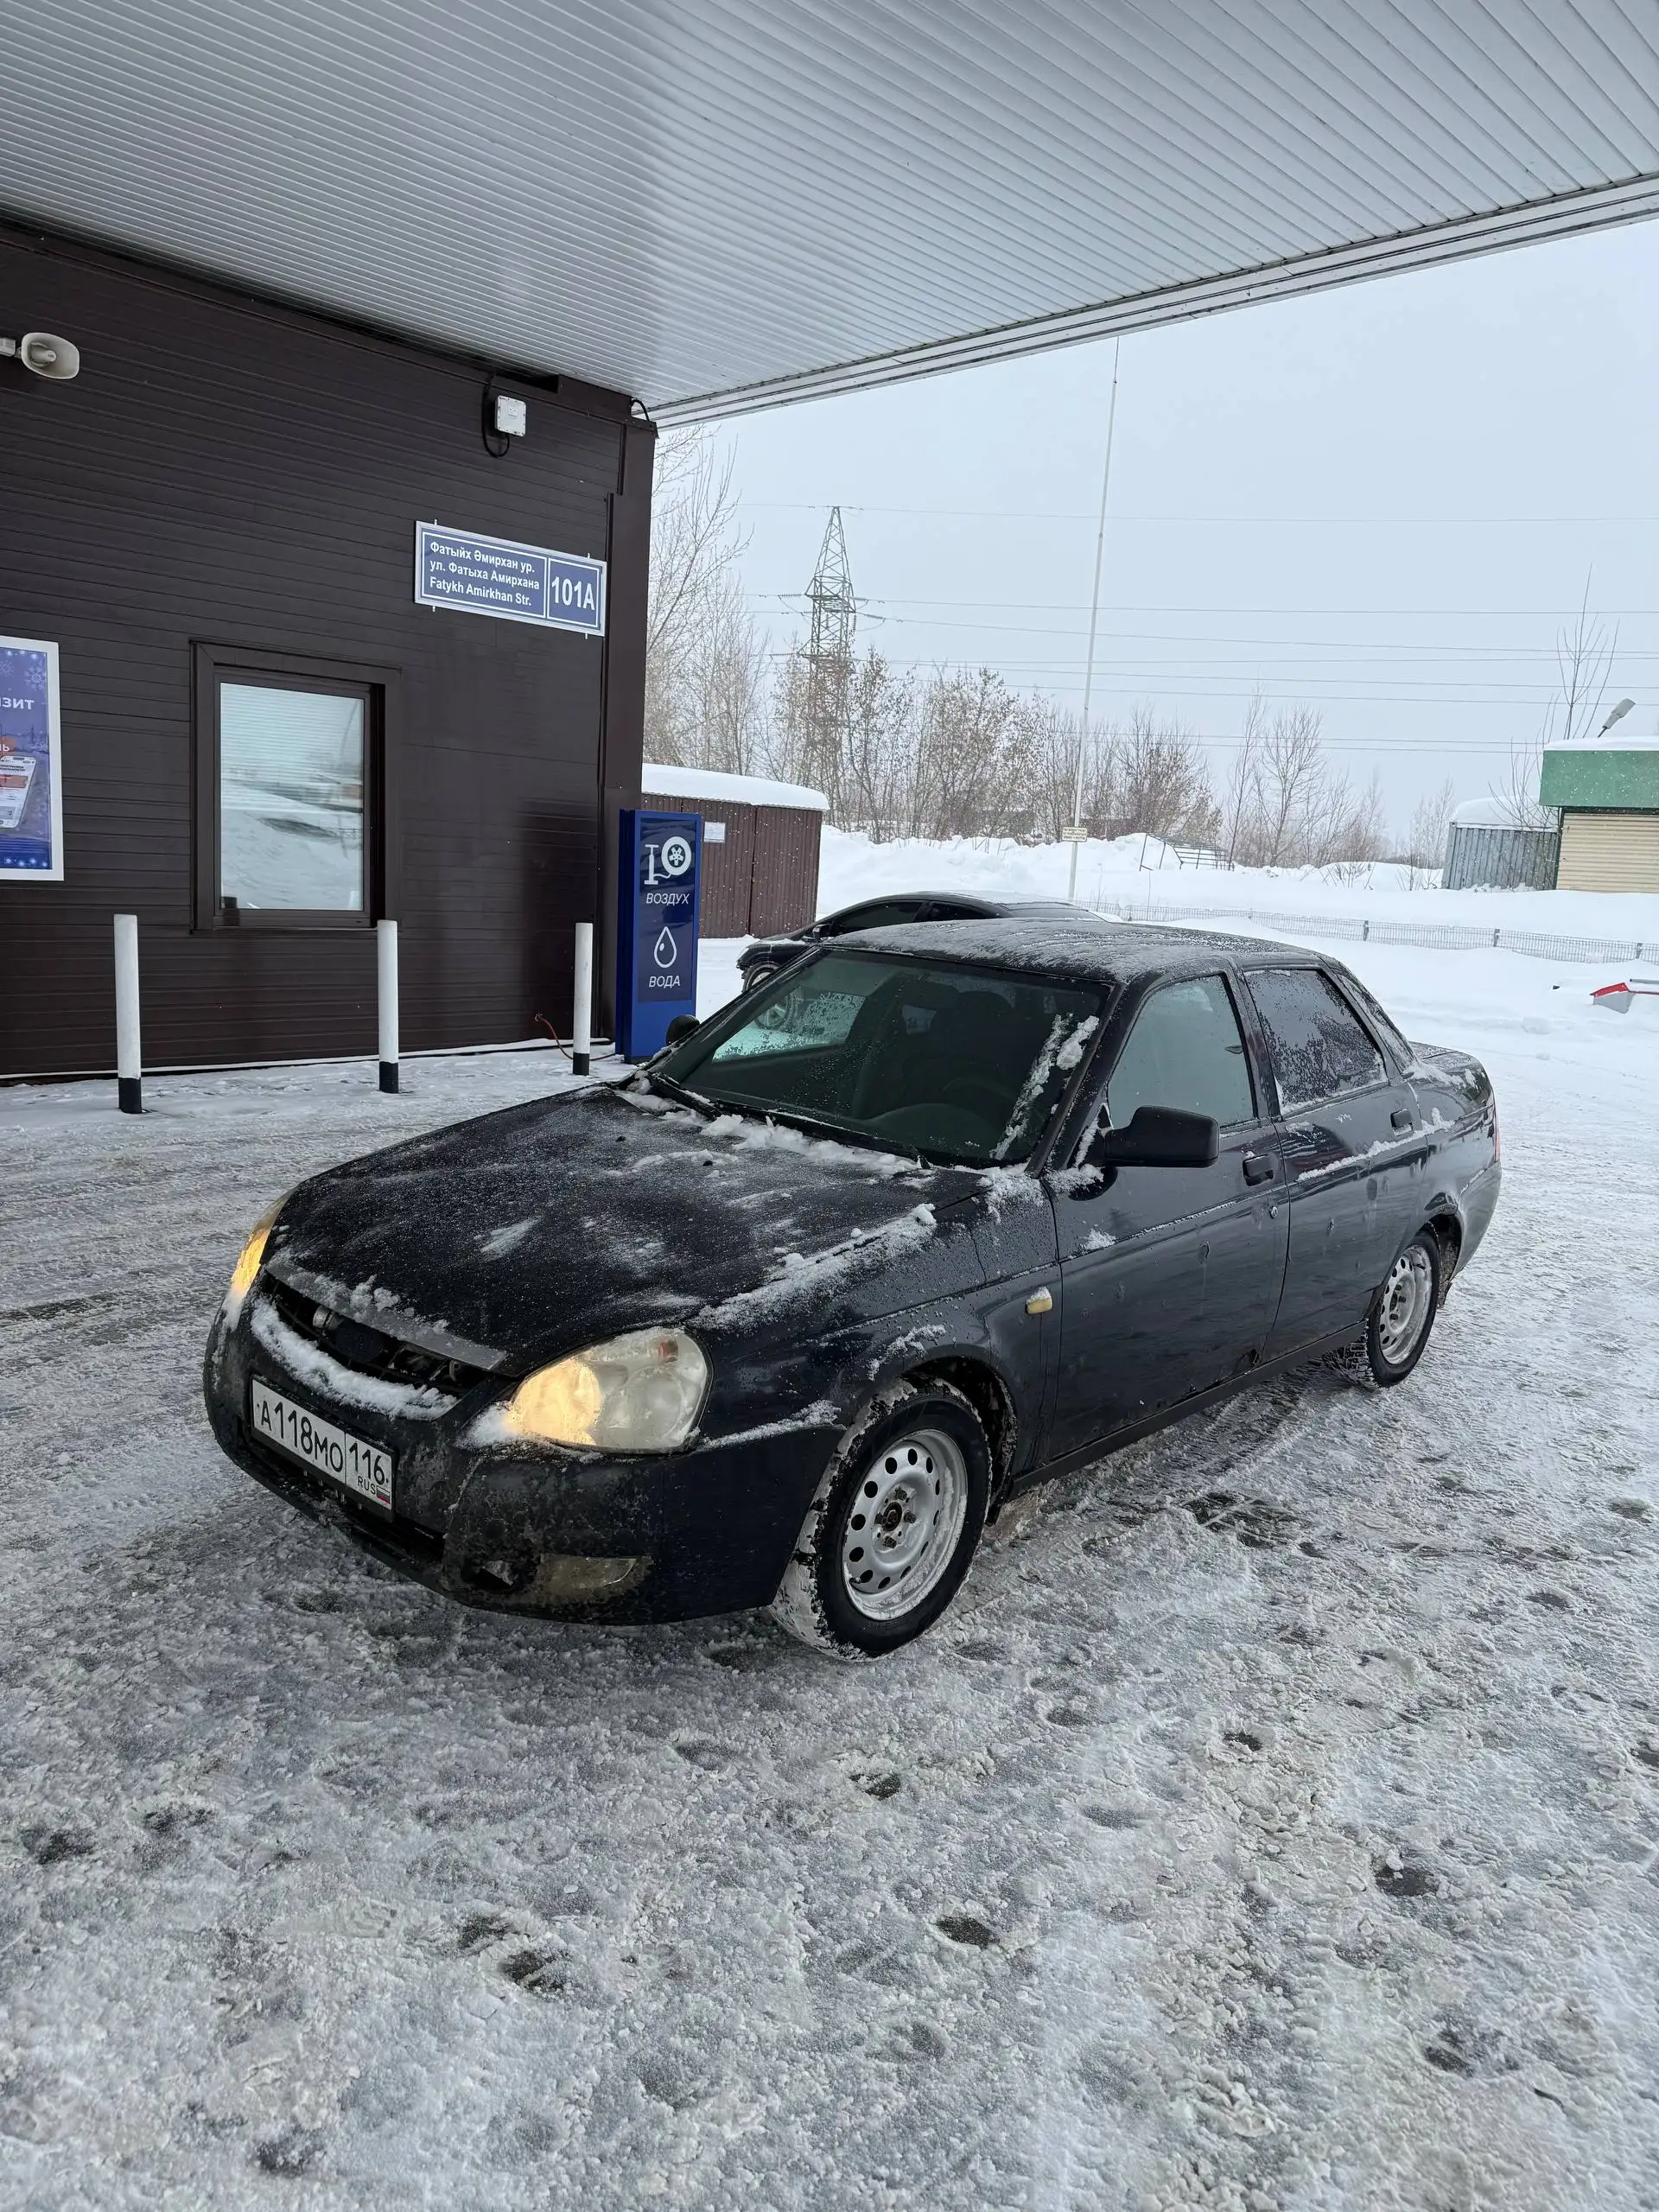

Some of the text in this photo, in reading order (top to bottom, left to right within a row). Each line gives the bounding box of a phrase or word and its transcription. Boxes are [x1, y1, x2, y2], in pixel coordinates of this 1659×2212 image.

[430, 541, 535, 574] Фатыйх Әмирхан ур.
[429, 561, 539, 590] ул. Фатыха Амирхана
[429, 576, 531, 607] Fatykh Amirkhan Str.
[645, 893, 690, 906] ВОЗДУХ
[648, 975, 681, 988] ВОДА
[348, 1442, 385, 1486] 116
[357, 1475, 376, 1495] RUS
